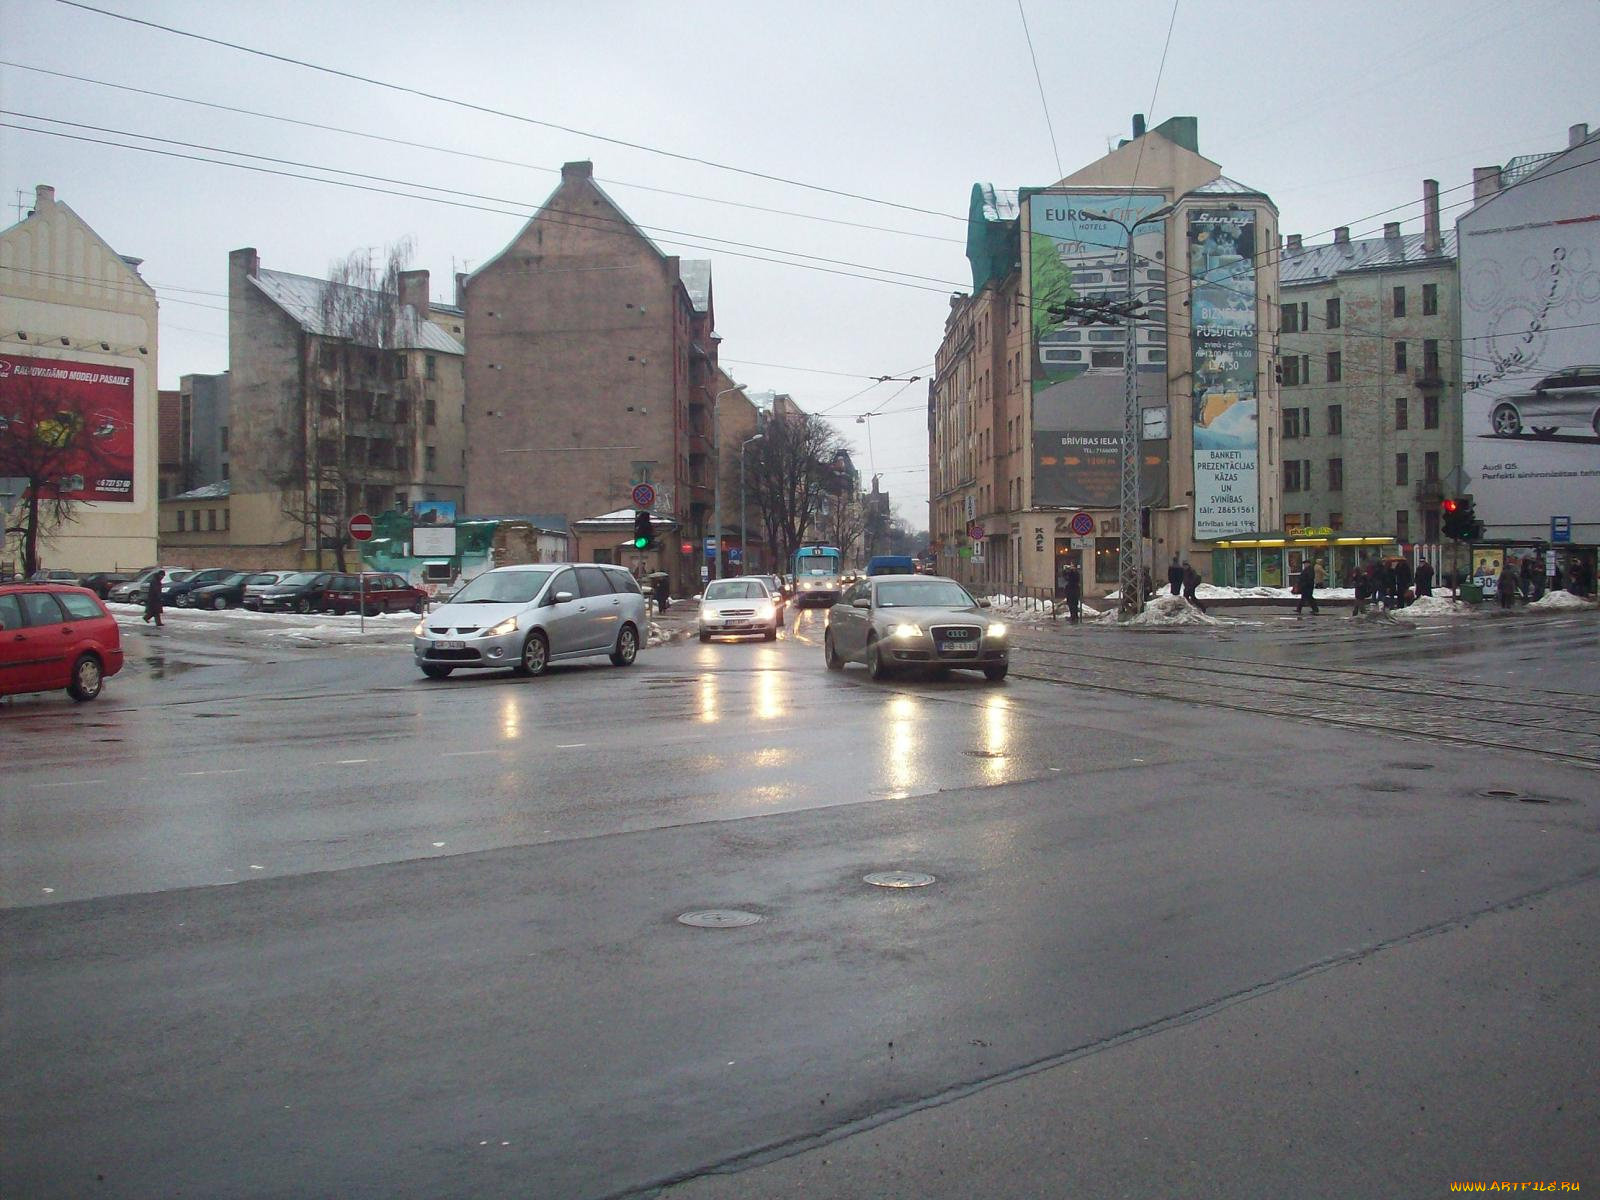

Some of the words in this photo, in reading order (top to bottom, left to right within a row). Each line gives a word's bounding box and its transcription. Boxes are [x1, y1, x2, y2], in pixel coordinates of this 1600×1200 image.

[1200, 213, 1250, 227] Sunny
[1079, 223, 1107, 231] HOTELS
[1196, 324, 1253, 337] PUSDIENAS
[69, 371, 98, 384] MODEĻU
[99, 374, 131, 386] PASAULE
[1100, 437, 1118, 445] IELA
[1210, 451, 1241, 459] BANKETI
[1197, 460, 1255, 470] PREZENTĀCIJAS
[1482, 463, 1503, 471] Audi
[1214, 471, 1238, 481] KĀZAS
[1481, 472, 1516, 480] Perfekti
[1210, 494, 1243, 503] SVINĪBAS
[1217, 506, 1255, 514] 28651561
